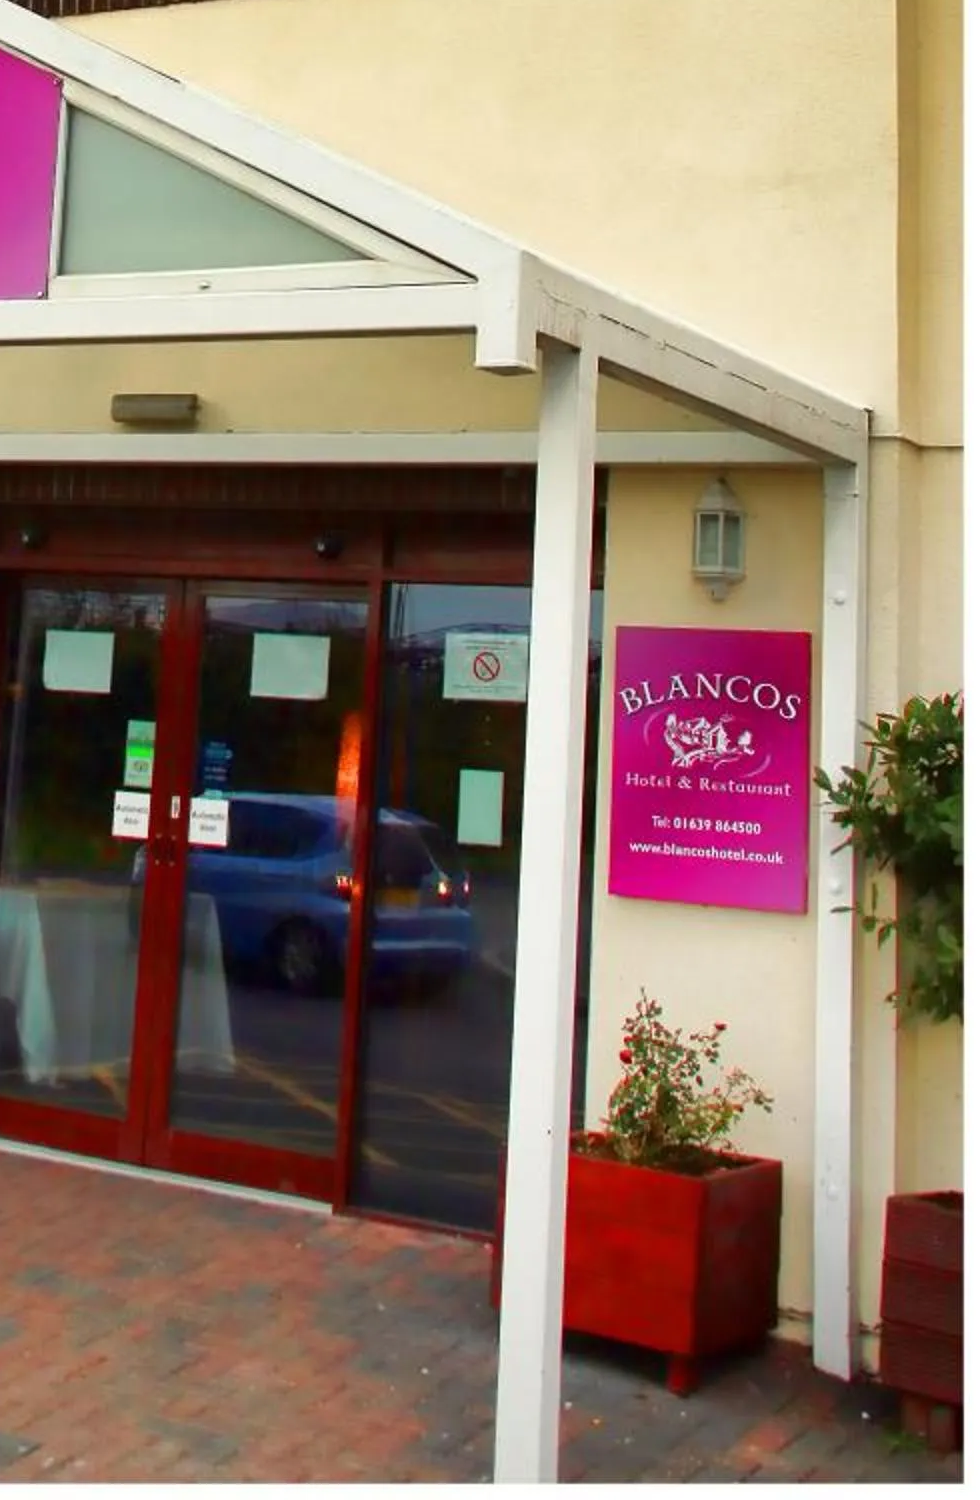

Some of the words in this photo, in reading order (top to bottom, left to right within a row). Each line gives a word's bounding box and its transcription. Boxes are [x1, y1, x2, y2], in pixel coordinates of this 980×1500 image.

[619, 672, 802, 720] BLANCOS
[625, 771, 671, 788] Hotel
[677, 775, 693, 790] &
[699, 777, 792, 797] Restaurant
[652, 815, 671, 829] Tel:
[673, 816, 711, 832] 01639
[715, 820, 761, 836] 864500
[629, 840, 784, 866] www.blancoshotel.co.uk
